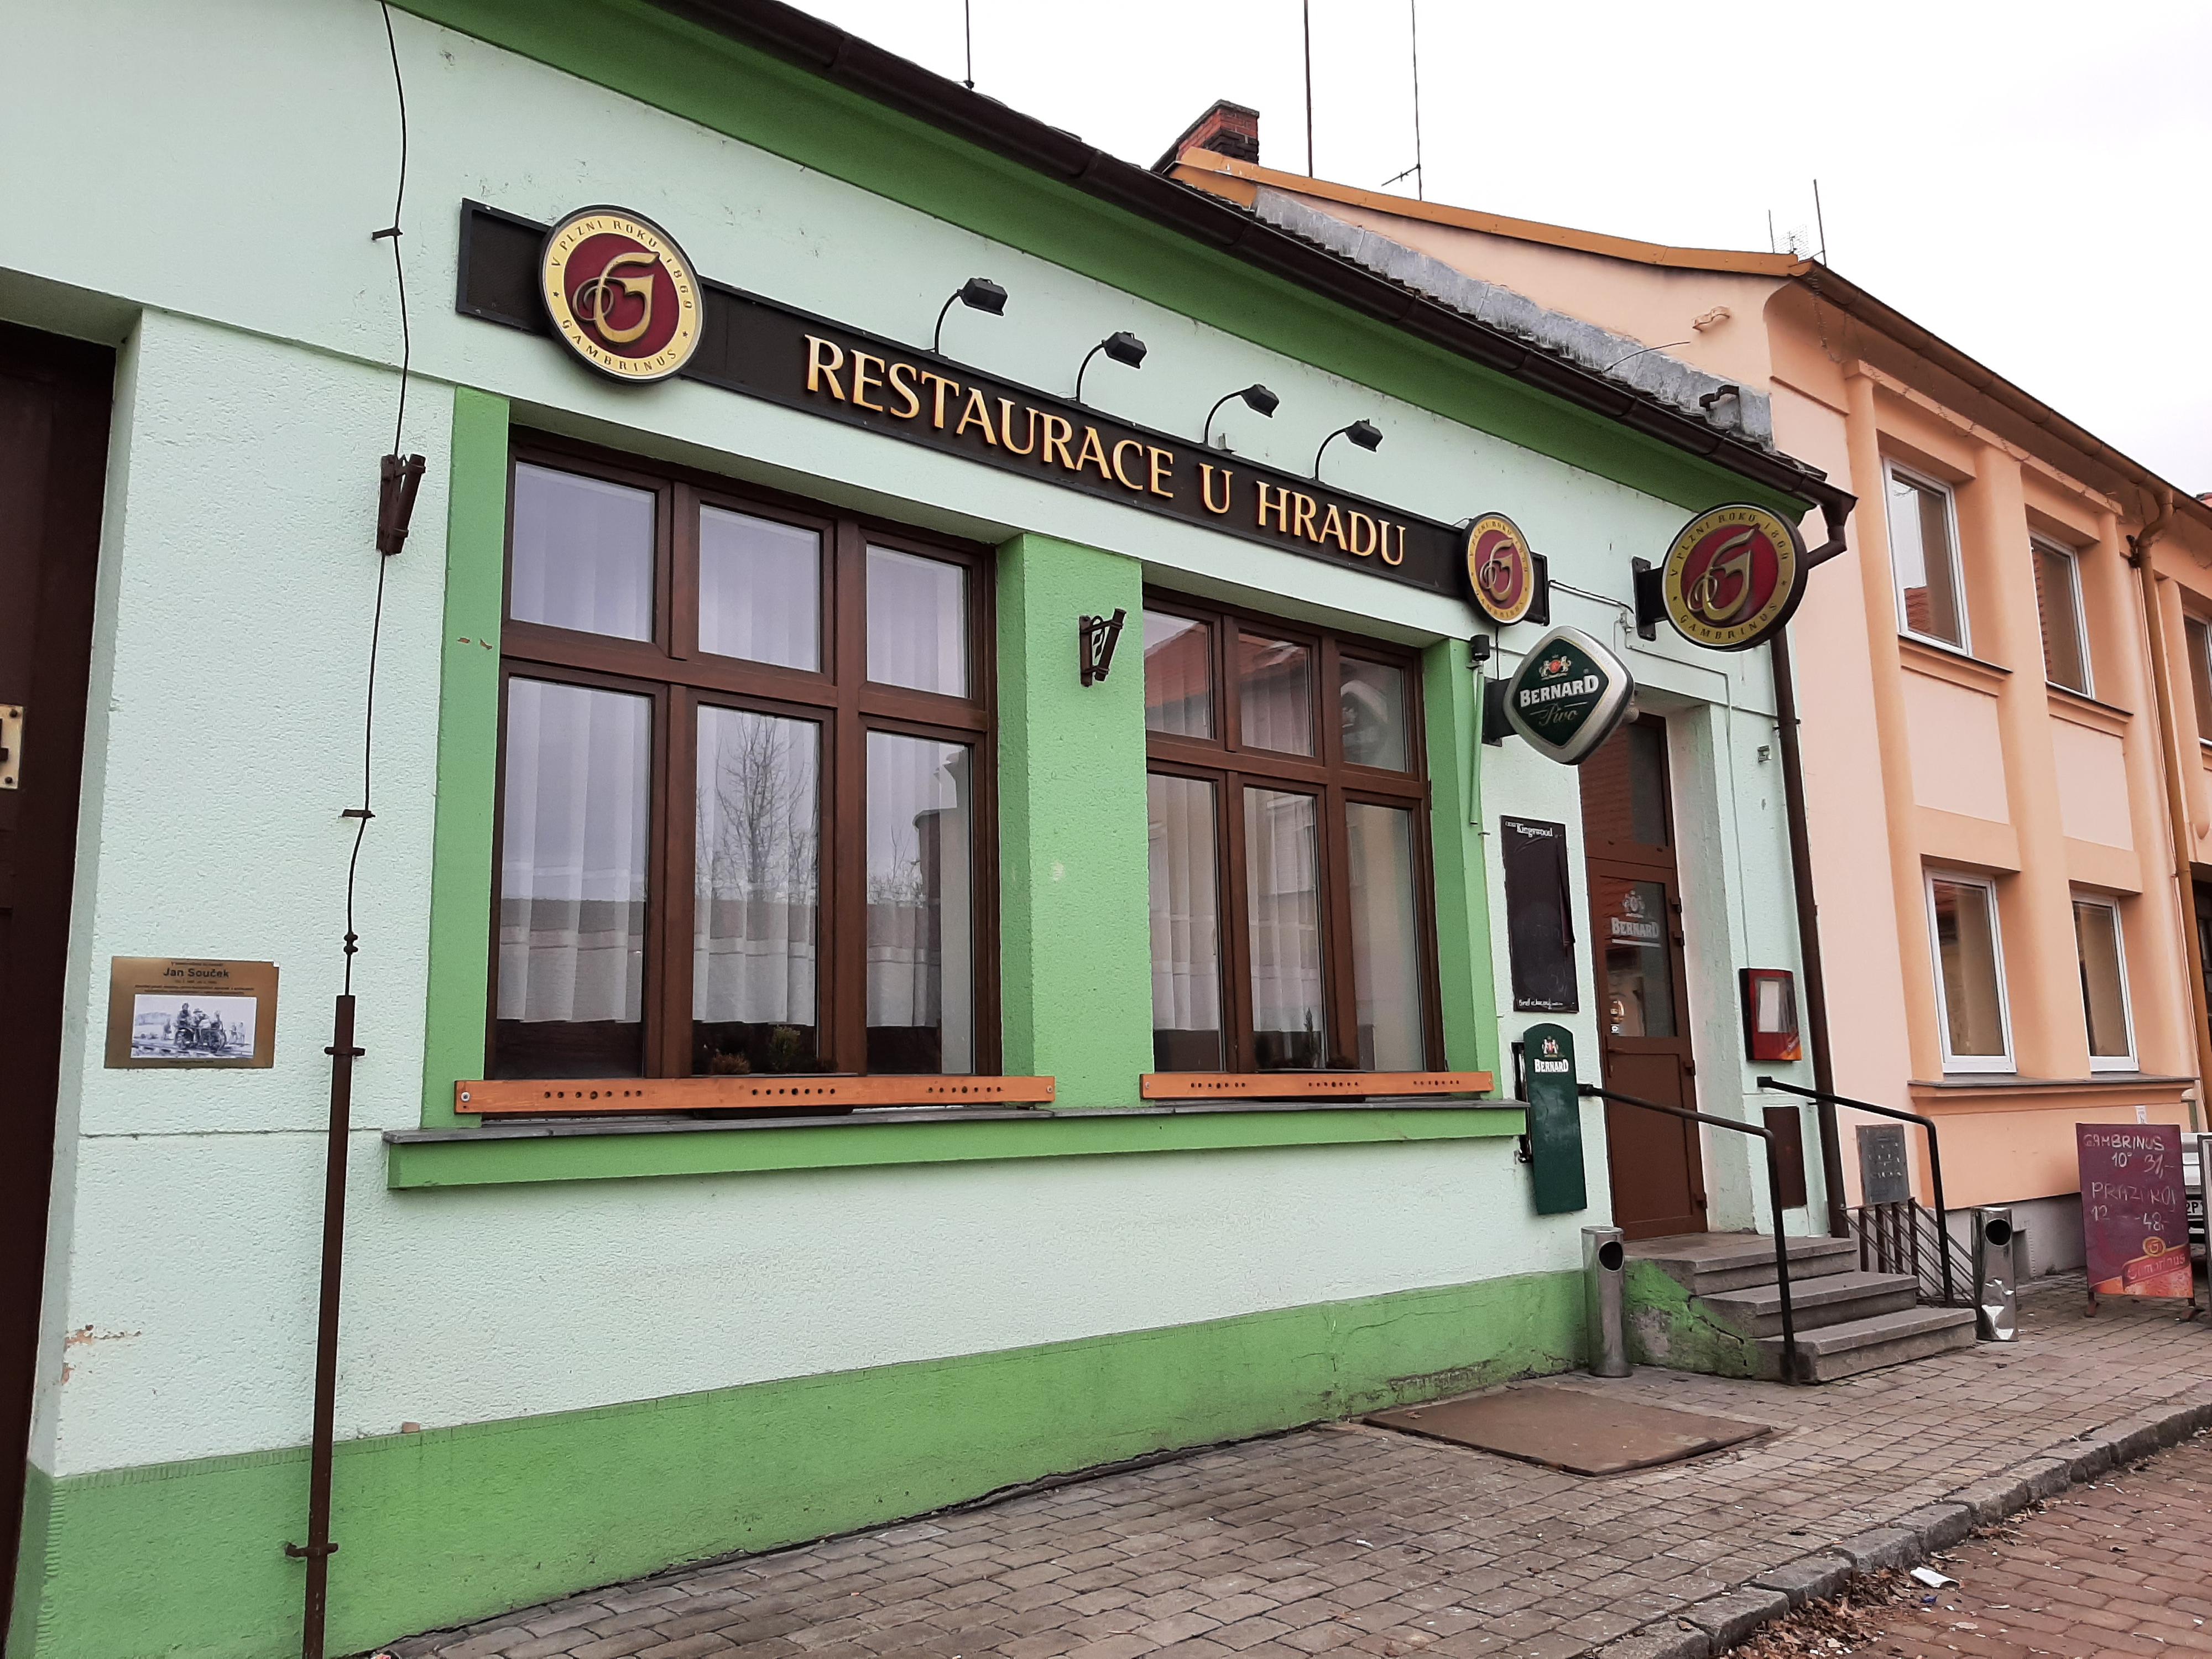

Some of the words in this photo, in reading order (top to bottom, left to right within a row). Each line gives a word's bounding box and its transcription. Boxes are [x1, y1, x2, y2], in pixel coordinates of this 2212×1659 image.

[551, 257, 561, 268] V
[613, 220, 657, 248] ROKU
[666, 257, 693, 309] 1869
[562, 319, 677, 372] GAMBRINUS
[804, 333, 1175, 498] RESTAURACE
[1199, 462, 1233, 513] U
[1256, 481, 1406, 566] HRADU
[1719, 513, 1756, 523] ROKU
[1681, 603, 1777, 639] GAMBRINUS
[1520, 675, 1599, 707] BERNARD
[1611, 917, 1658, 938] BERNARD
[163, 968, 184, 977] Jan
[188, 968, 229, 978] Souček
[1535, 1059, 1569, 1072] BERNARD
[2083, 1134, 2164, 1150] GAMBRINUS
